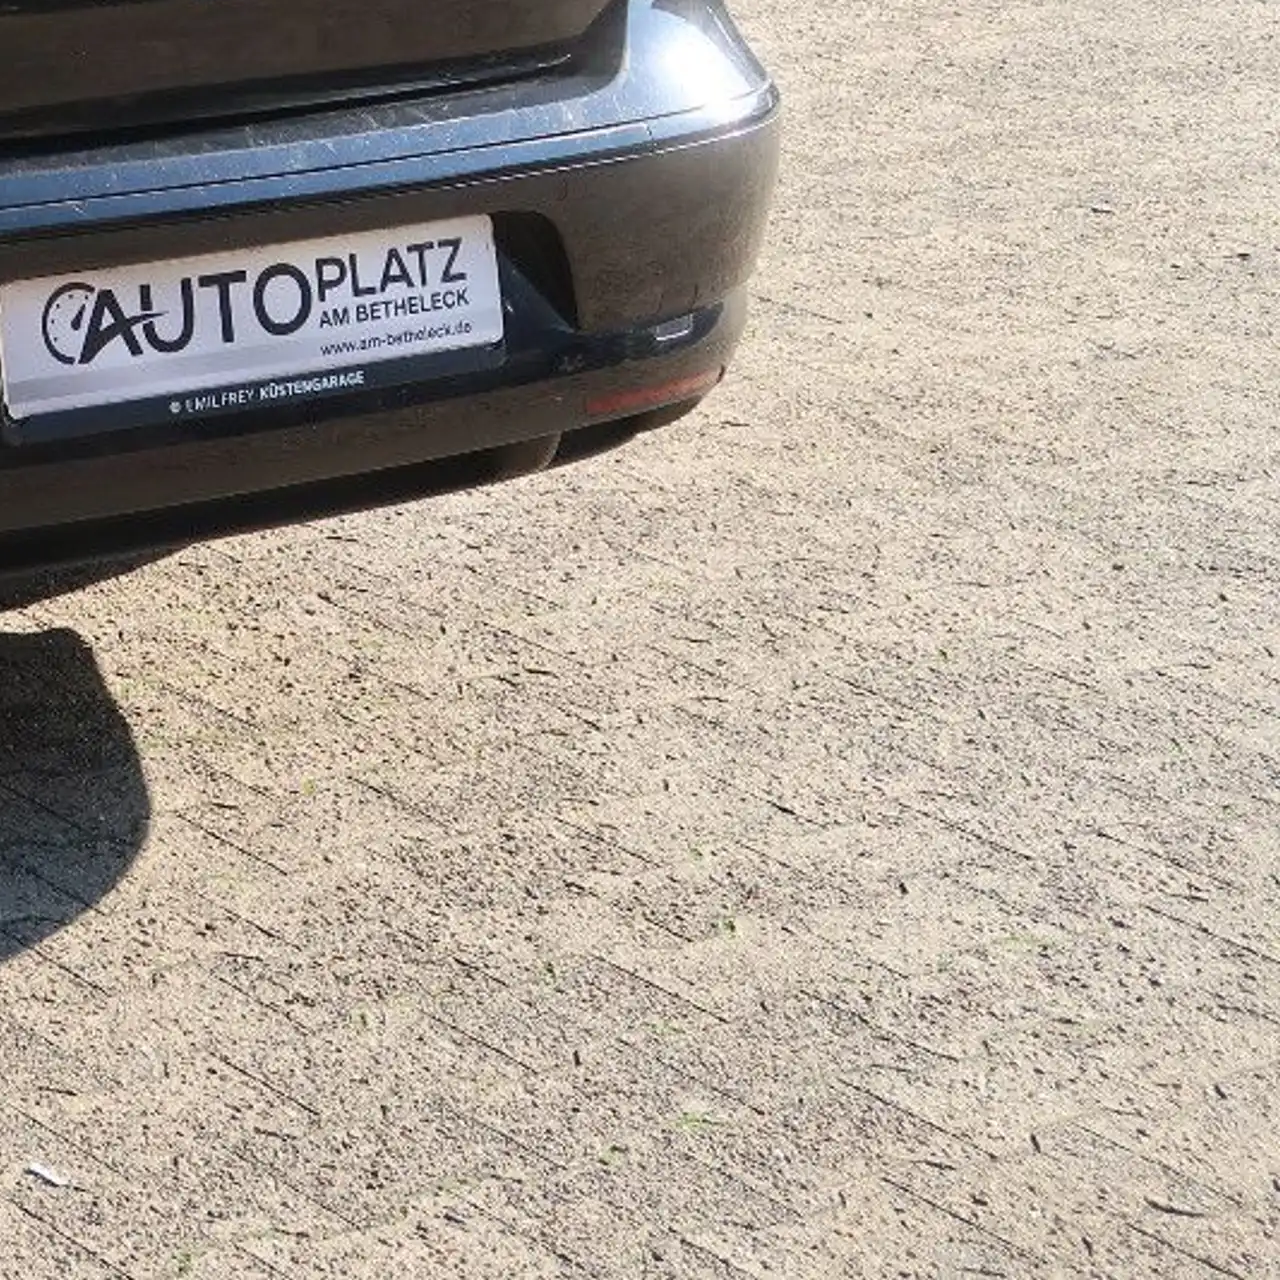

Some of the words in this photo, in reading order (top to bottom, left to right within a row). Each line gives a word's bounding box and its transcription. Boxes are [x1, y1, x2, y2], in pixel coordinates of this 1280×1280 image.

[319, 306, 350, 328] AM
[355, 287, 470, 323] BETHELECK
[319, 321, 473, 357] www.am-betheleck.de
[259, 370, 365, 401] KÜSTENGARAGE
